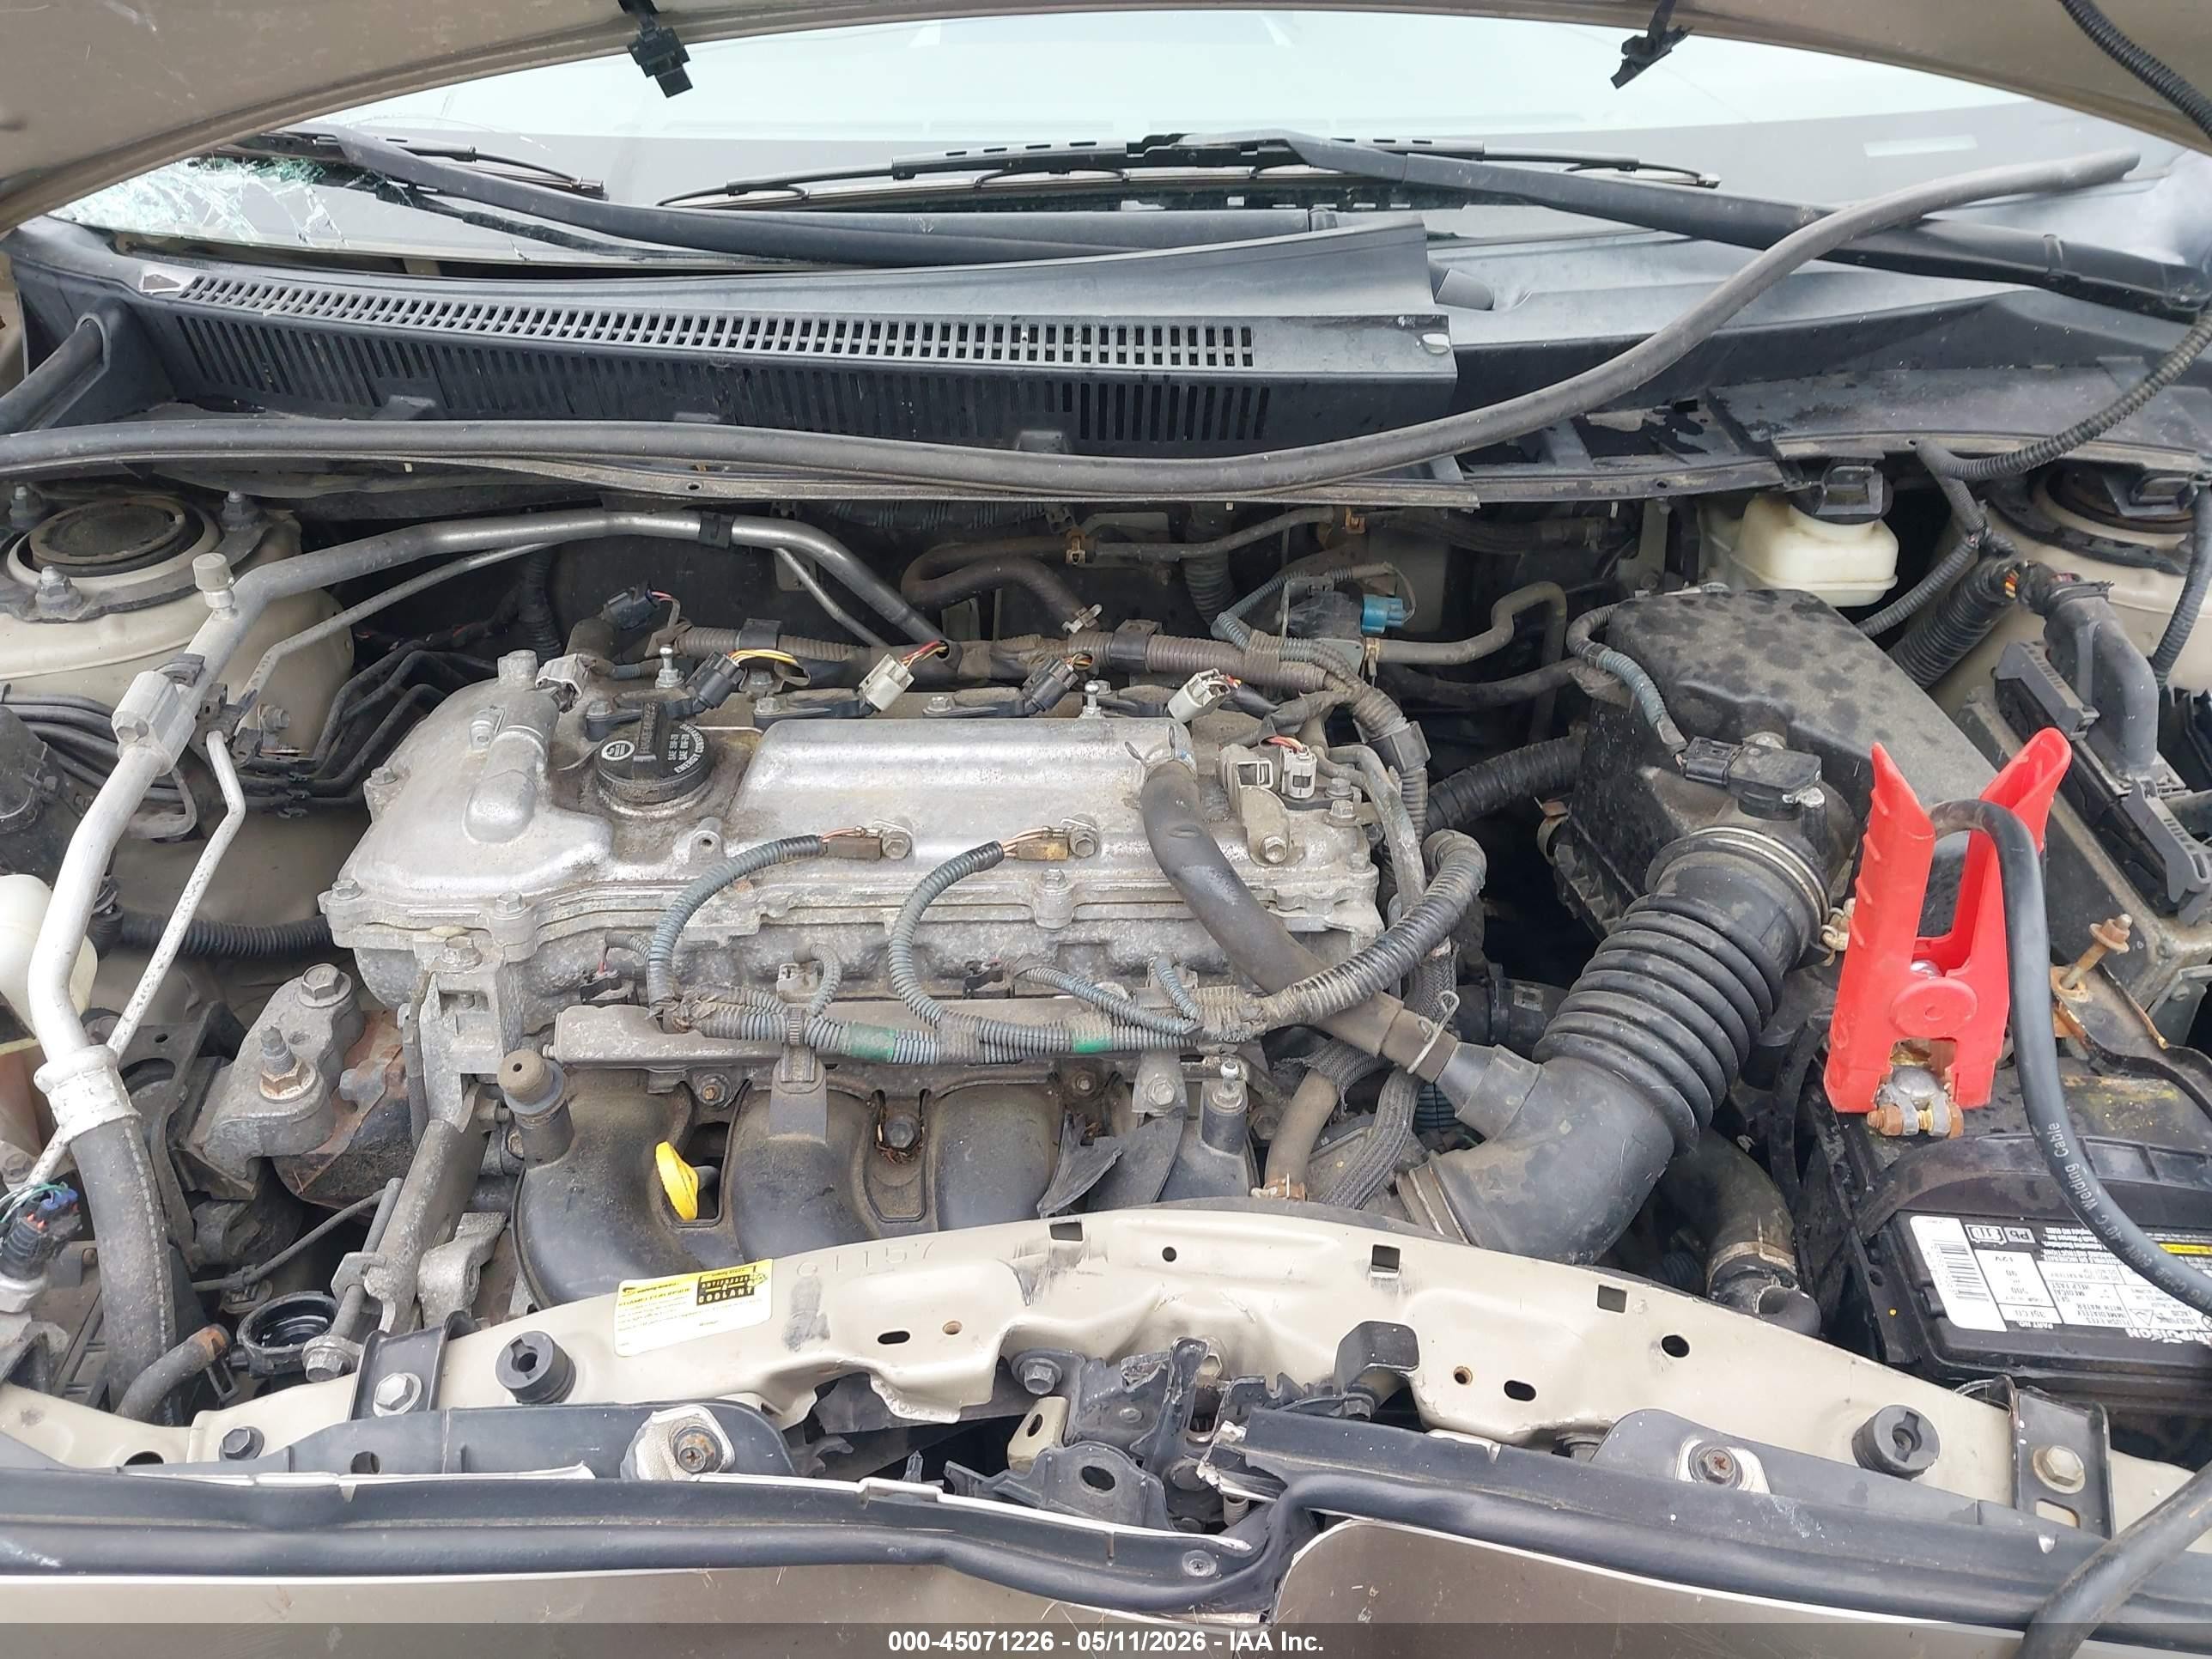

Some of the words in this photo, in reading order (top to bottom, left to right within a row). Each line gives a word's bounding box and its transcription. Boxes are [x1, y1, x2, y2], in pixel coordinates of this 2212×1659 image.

[2046, 1121, 2069, 1158] Cable
[2064, 1163, 2099, 1210] Welding
[2009, 1230, 2030, 1240] Pb
[697, 1287, 753, 1304] COOLANT
